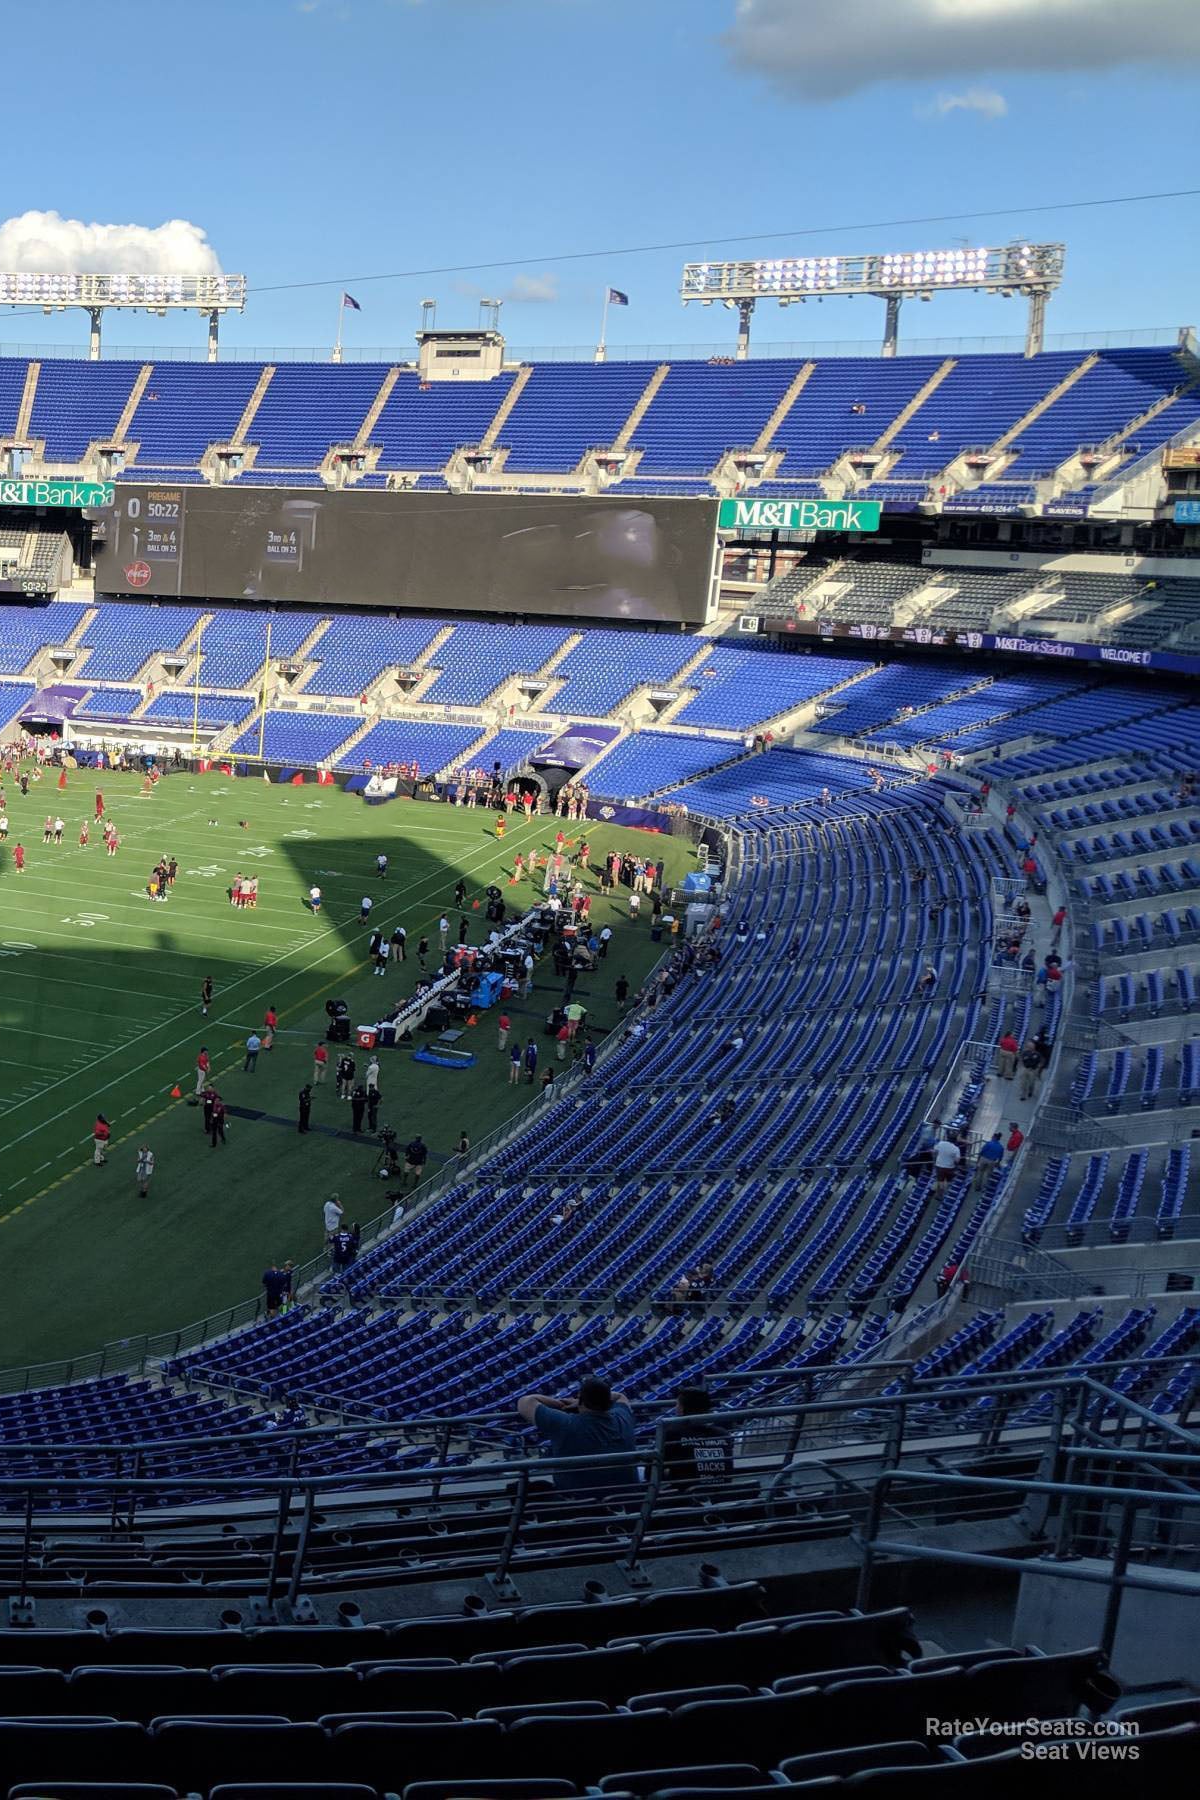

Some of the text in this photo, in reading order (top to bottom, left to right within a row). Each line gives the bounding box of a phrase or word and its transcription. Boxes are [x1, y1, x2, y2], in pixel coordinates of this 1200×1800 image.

[35, 482, 85, 505] Bank
[147, 491, 181, 501] PREGAME
[128, 498, 140, 518] 0
[147, 503, 179, 517] 50:22
[1048, 507, 1084, 515] RAVENS
[733, 500, 862, 529] M&T Bank
[169, 530, 176, 543] 4
[289, 531, 296, 544] 4
[147, 544, 160, 552] BALL
[267, 545, 280, 553] BALL
[22, 581, 46, 592] 50:22
[995, 637, 1075, 656] M&T Bank Stadium
[1101, 648, 1141, 663] WELCOME
[360, 1033, 370, 1043] G
[695, 1448, 725, 1458] NEVER
[696, 1462, 726, 1472] BACKS
